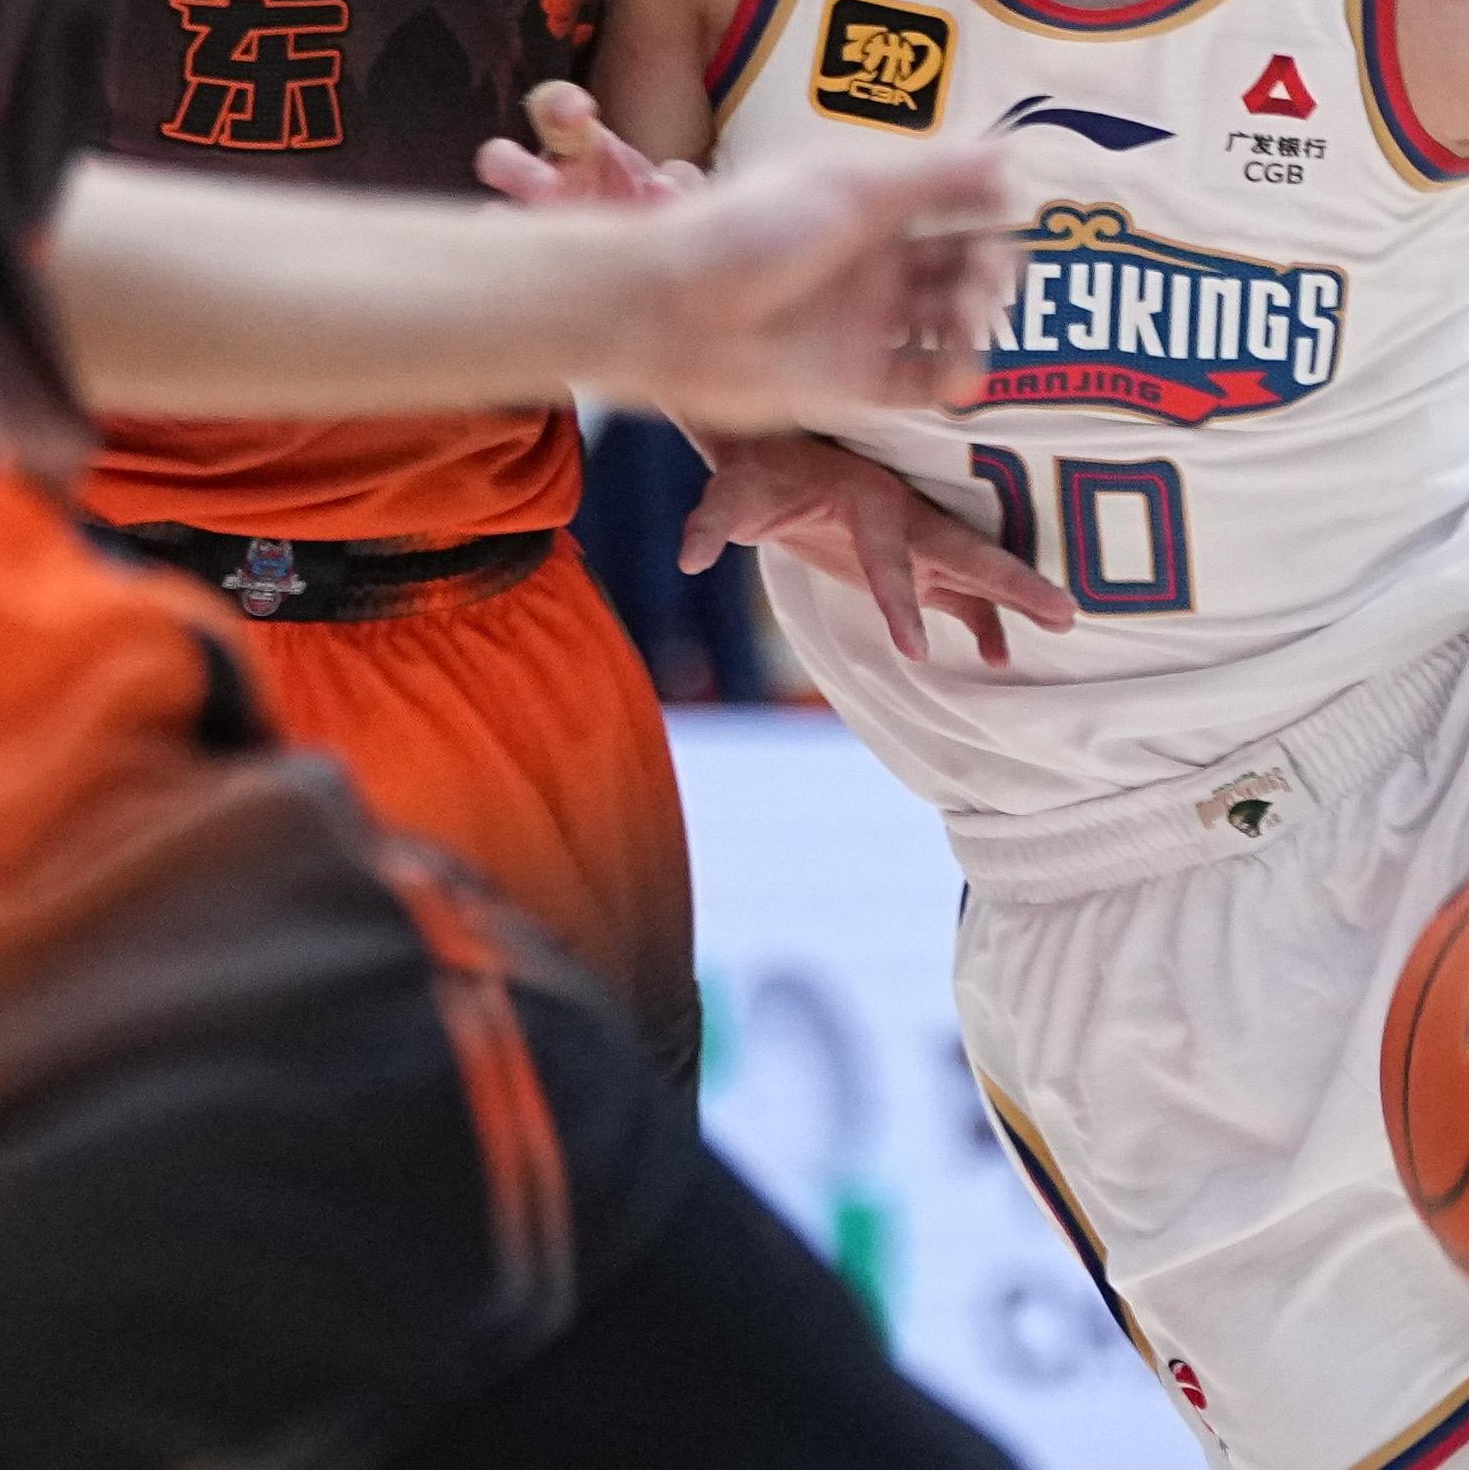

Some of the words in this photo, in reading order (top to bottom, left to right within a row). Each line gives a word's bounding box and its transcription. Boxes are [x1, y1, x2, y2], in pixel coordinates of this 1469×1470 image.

[1226, 130, 1328, 159] 广发银行
[1244, 161, 1305, 185] CGB
[987, 370, 1163, 404] NANJING
